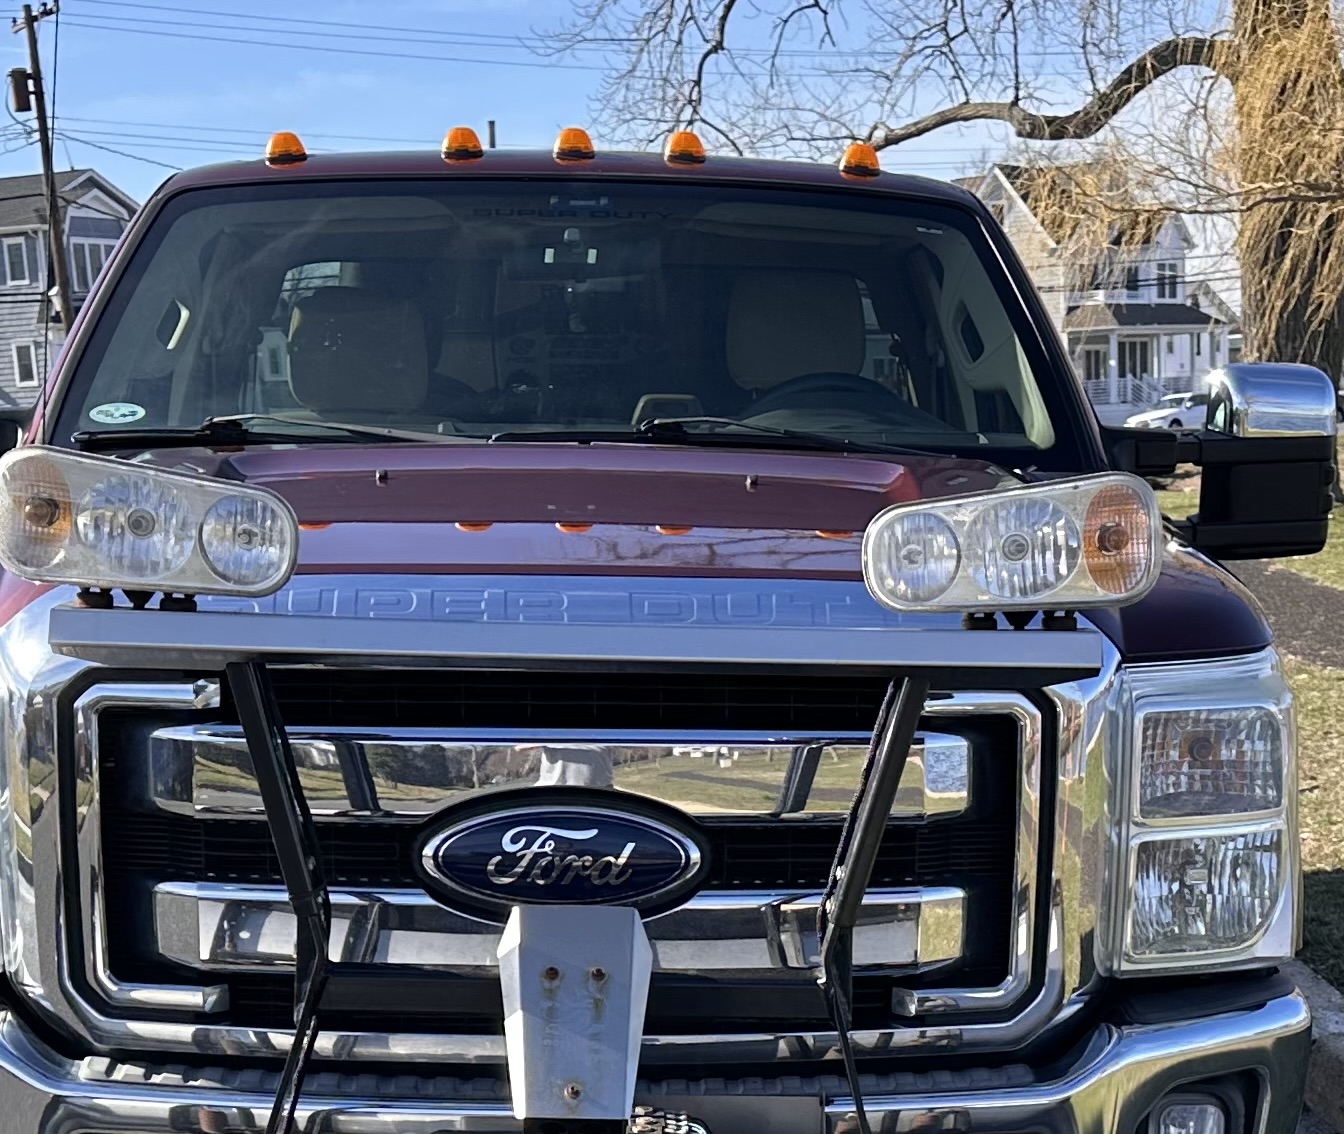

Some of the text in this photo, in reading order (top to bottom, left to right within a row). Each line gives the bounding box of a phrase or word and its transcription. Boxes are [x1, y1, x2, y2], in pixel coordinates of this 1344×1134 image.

[472, 207, 674, 220] SUPER DUTY
[486, 825, 636, 886] Ford
